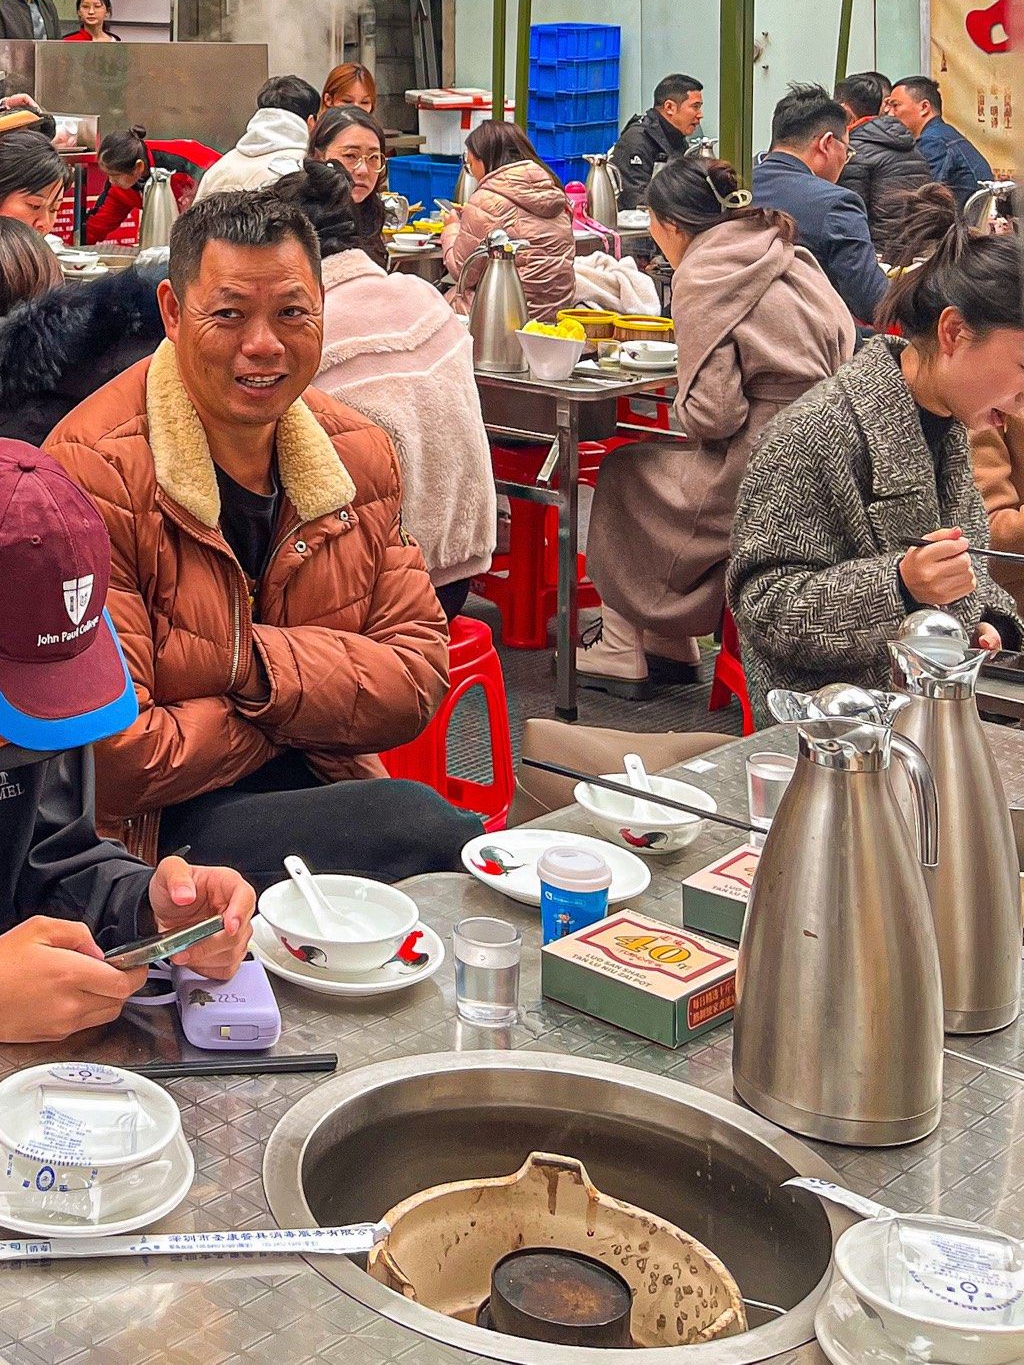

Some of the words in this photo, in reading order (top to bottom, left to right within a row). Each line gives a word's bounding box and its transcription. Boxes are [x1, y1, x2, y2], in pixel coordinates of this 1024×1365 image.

[37, 633, 60, 647] John
[61, 626, 79, 643] Paul
[572, 953, 589, 964] TAN
[589, 960, 601, 968] LU
[601, 965, 618, 975] NIU
[617, 972, 633, 981] ZAI
[632, 977, 653, 988] POT
[586, 953, 604, 963] LUO
[604, 960, 622, 970] SAN
[622, 967, 647, 979] SHAO
